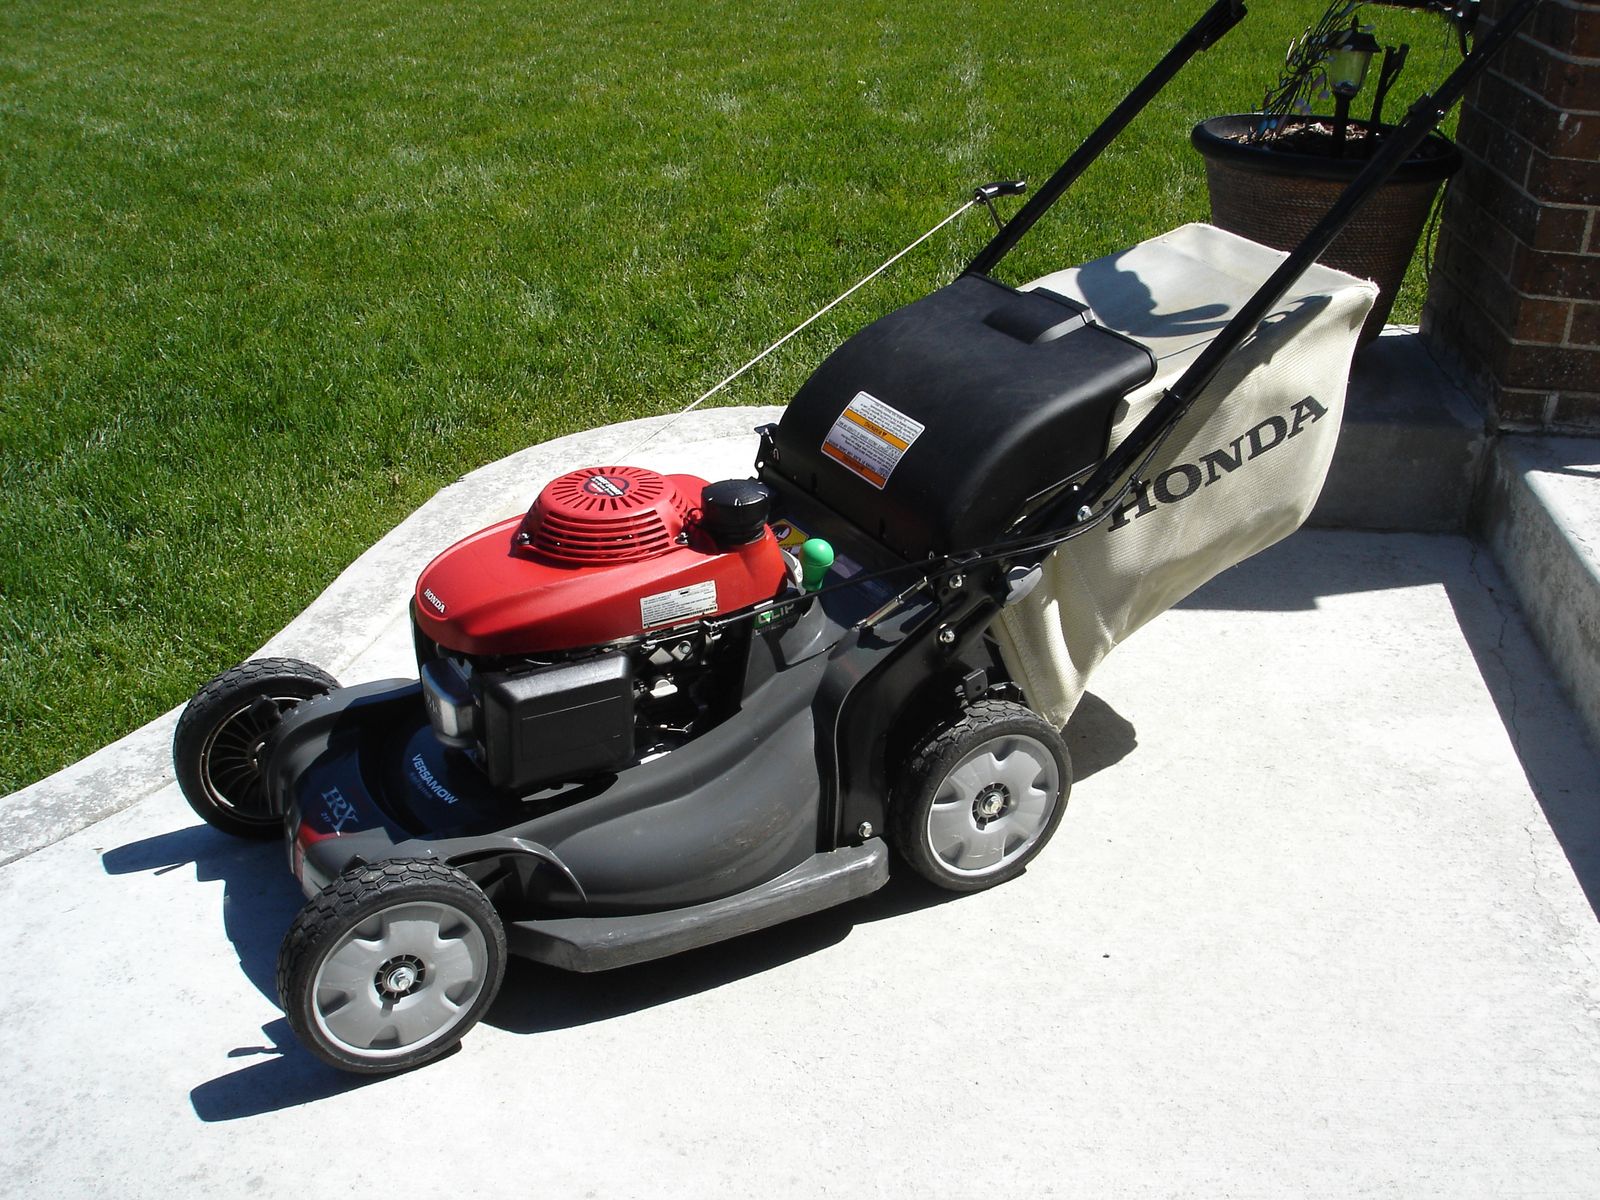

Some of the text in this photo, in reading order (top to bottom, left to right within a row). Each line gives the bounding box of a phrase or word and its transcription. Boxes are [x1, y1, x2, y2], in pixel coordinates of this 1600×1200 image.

[1103, 395, 1329, 532] HONDA
[423, 588, 446, 614] HONDA
[412, 753, 459, 804] VERSAMOW
[320, 786, 360, 837] HRX
